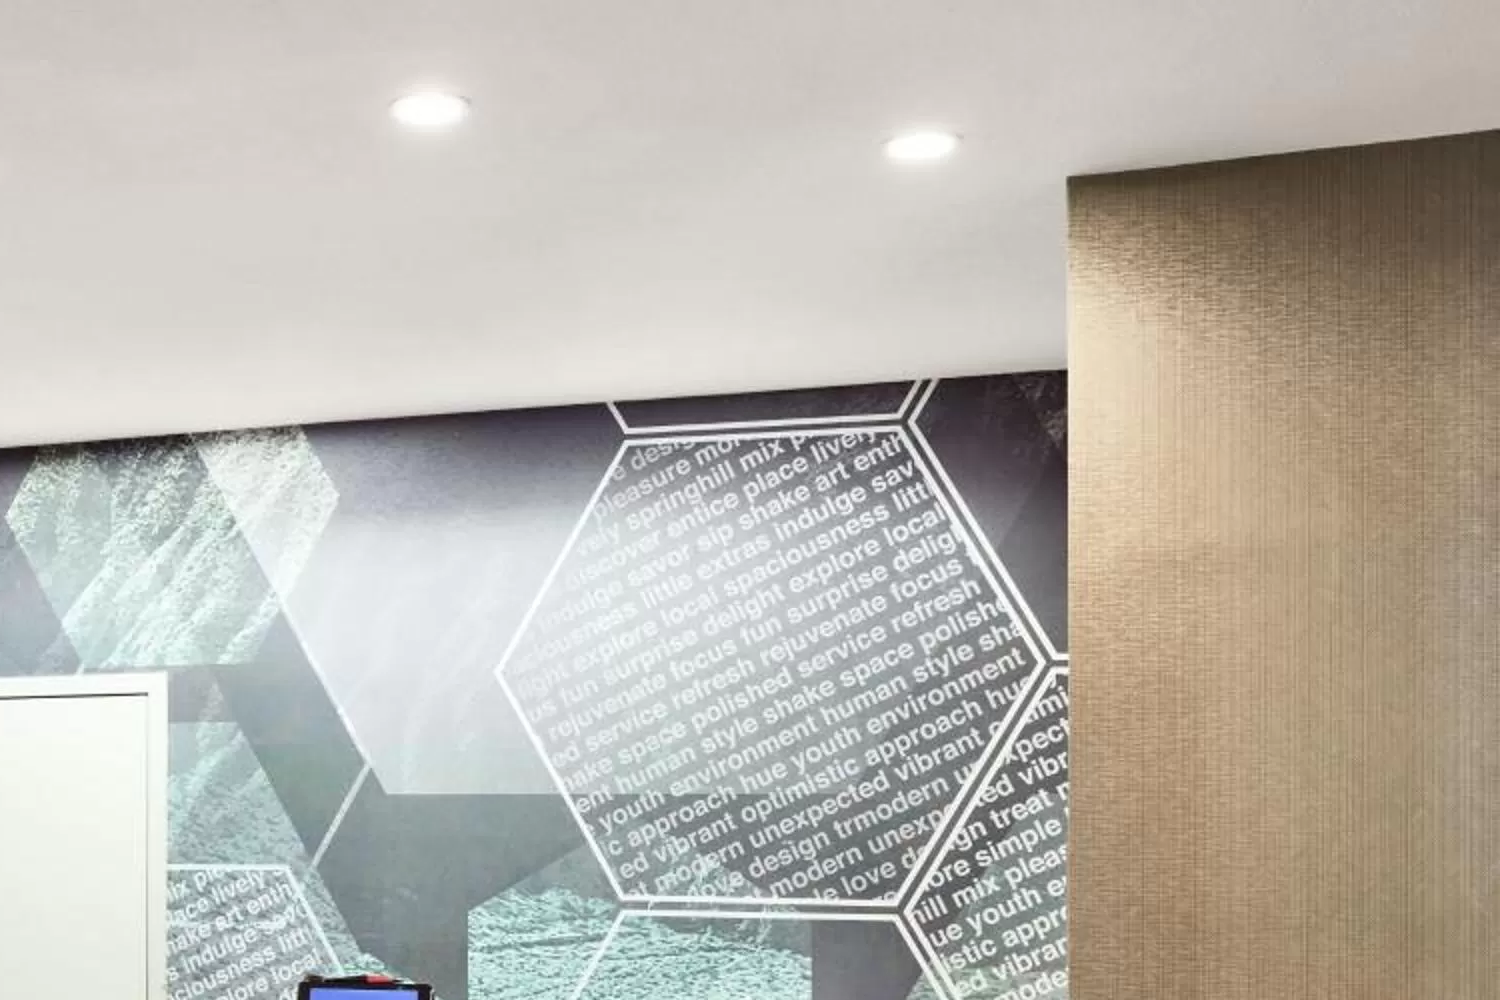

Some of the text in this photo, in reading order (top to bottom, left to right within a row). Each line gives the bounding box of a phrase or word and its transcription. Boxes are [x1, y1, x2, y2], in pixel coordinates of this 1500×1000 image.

[594, 458, 692, 524] pleasure
[626, 460, 736, 530] springhill
[739, 438, 785, 473] mix
[627, 543, 692, 587] savor
[698, 523, 734, 549] sip
[738, 484, 811, 531] shake
[815, 461, 850, 492] art
[667, 492, 739, 538] entice
[743, 456, 809, 501] place
[574, 619, 659, 673] explore
[661, 586, 719, 627] local
[724, 504, 890, 597] spaciousness
[640, 572, 694, 608] little
[697, 534, 771, 579] extras
[773, 485, 867, 542] indulge
[549, 673, 666, 742] rejuvenate
[669, 640, 737, 681] focus
[741, 615, 782, 646] fun
[787, 564, 889, 624] surprise
[560, 679, 599, 708] fun
[604, 629, 698, 685] surprise
[702, 583, 786, 636] delight
[789, 538, 881, 593] explore
[883, 501, 947, 547] local
[586, 702, 668, 751] service
[671, 658, 756, 710] refresh
[760, 594, 888, 666] rejuvenate
[889, 558, 963, 603] focus
[613, 746, 697, 795] human
[700, 715, 759, 755] style
[763, 679, 836, 725] shake
[839, 641, 914, 688] space
[617, 721, 687, 766] space
[691, 667, 793, 735] polished
[797, 625, 888, 678] service
[890, 578, 982, 633] refresh
[599, 789, 665, 836] youth
[670, 714, 820, 798] environment
[820, 674, 909, 726] human
[911, 637, 975, 685] style
[627, 782, 737, 848] approach
[739, 761, 788, 794] hue
[790, 724, 862, 774] youth
[866, 647, 1026, 734] environment
[653, 812, 738, 863] vibrant
[741, 756, 860, 823] optimistic
[864, 699, 983, 766] approach
[654, 840, 745, 893] modern
[749, 770, 891, 849] unexpected
[894, 727, 985, 782] vibrant
[748, 831, 830, 879] design
[833, 777, 949, 839] trmodern
[975, 819, 1062, 866] simple
[990, 788, 1054, 828] treat
[215, 905, 244, 930] art
[769, 847, 863, 898] modern
[841, 861, 896, 896] love
[952, 875, 1000, 908] mix
[966, 887, 1042, 936] youth
[181, 927, 257, 975] indulge
[270, 948, 323, 984] local
